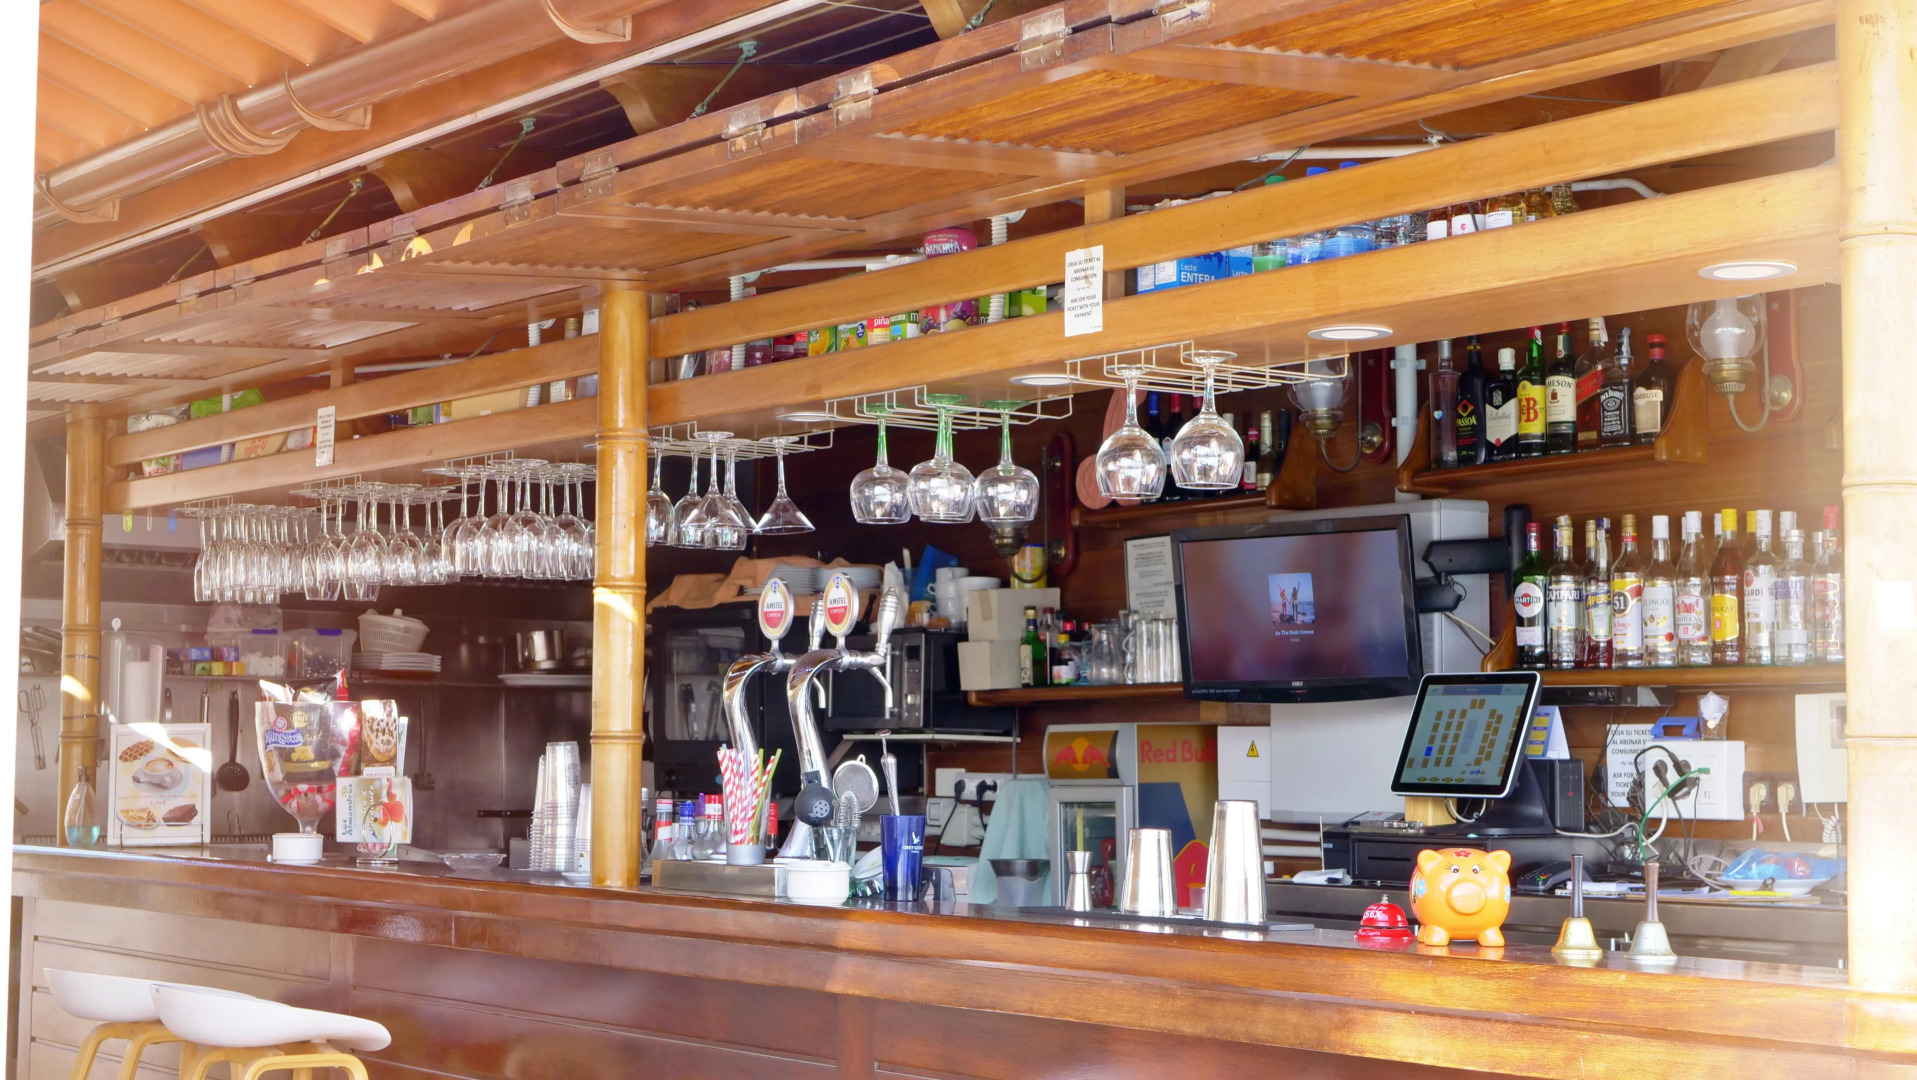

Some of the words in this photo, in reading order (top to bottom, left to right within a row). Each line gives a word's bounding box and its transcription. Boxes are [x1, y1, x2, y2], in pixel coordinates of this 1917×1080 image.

[1181, 263, 1198, 271] Leche
[1181, 271, 1216, 283] ENTERA
[874, 316, 889, 327] piña
[829, 597, 846, 605] AMSTEL
[1516, 596, 1541, 604] MARTINI
[1587, 592, 1613, 607] APERO
[1613, 595, 1626, 610] 51
[766, 601, 783, 610] AMSTEL
[1140, 738, 1177, 763] Red
[1181, 738, 1216, 763] Bull
[1363, 910, 1383, 919] SEX
